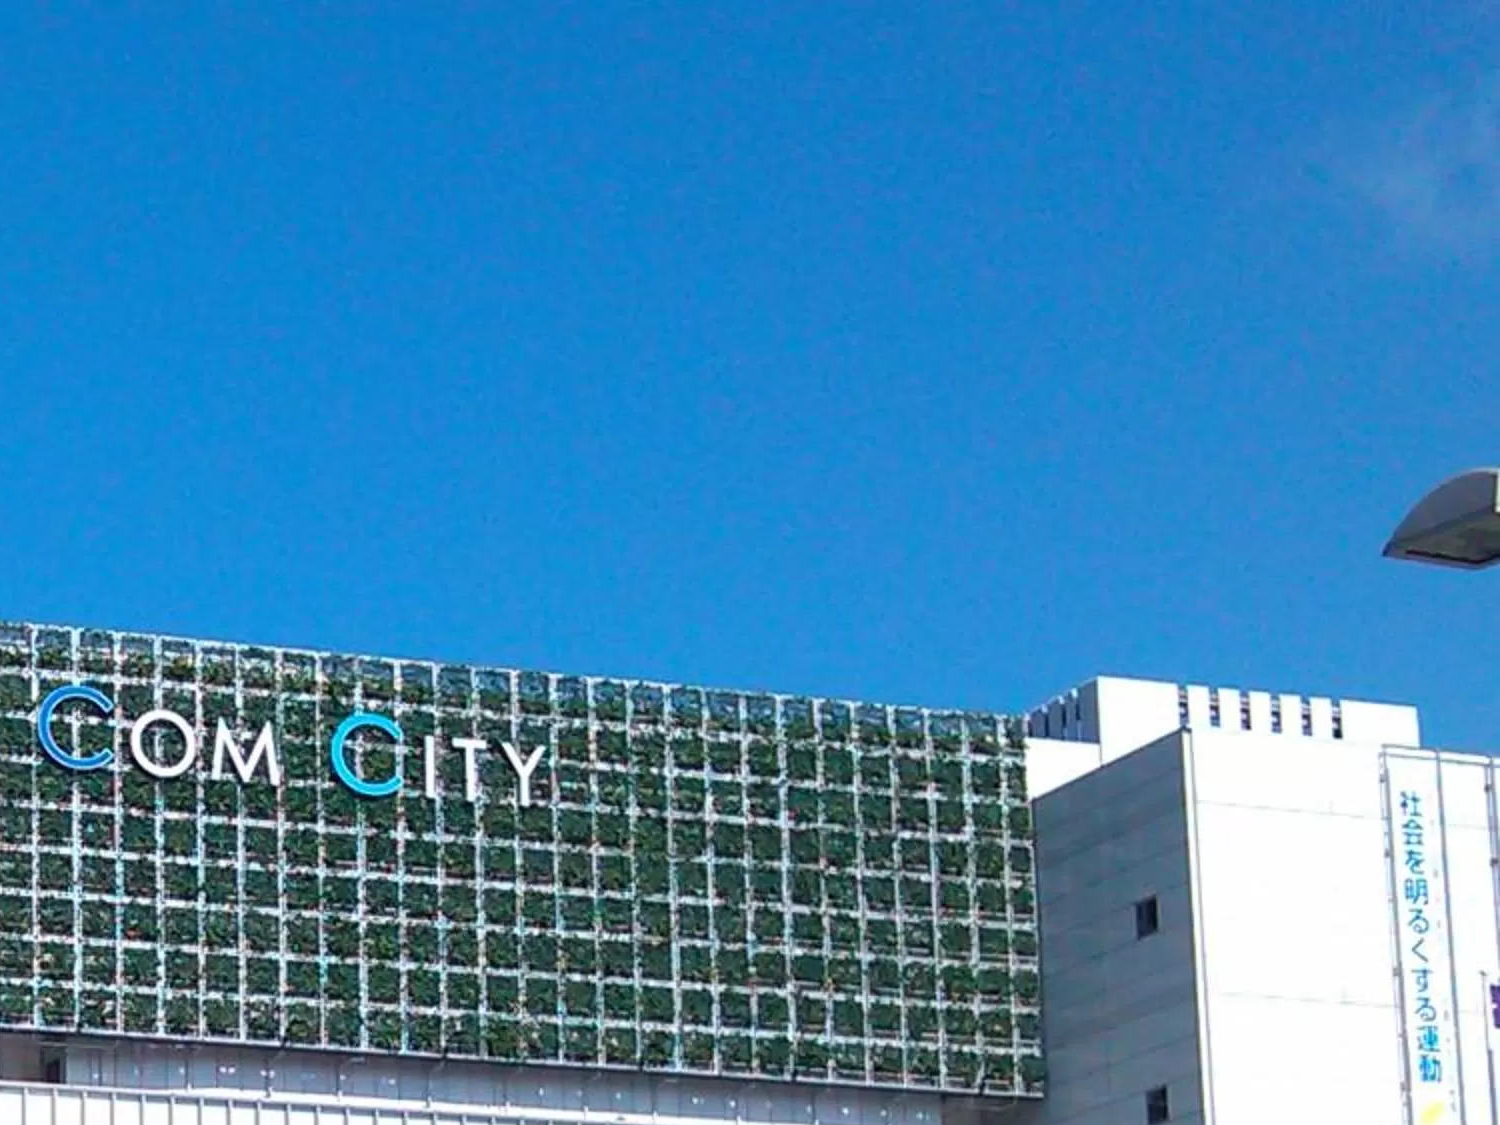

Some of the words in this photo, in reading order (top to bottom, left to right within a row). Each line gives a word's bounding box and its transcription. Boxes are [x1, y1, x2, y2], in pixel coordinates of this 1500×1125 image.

[37, 684, 282, 787] COM
[331, 711, 547, 807] CITY
[1400, 791, 1443, 1083] 社会を明るくする運動
